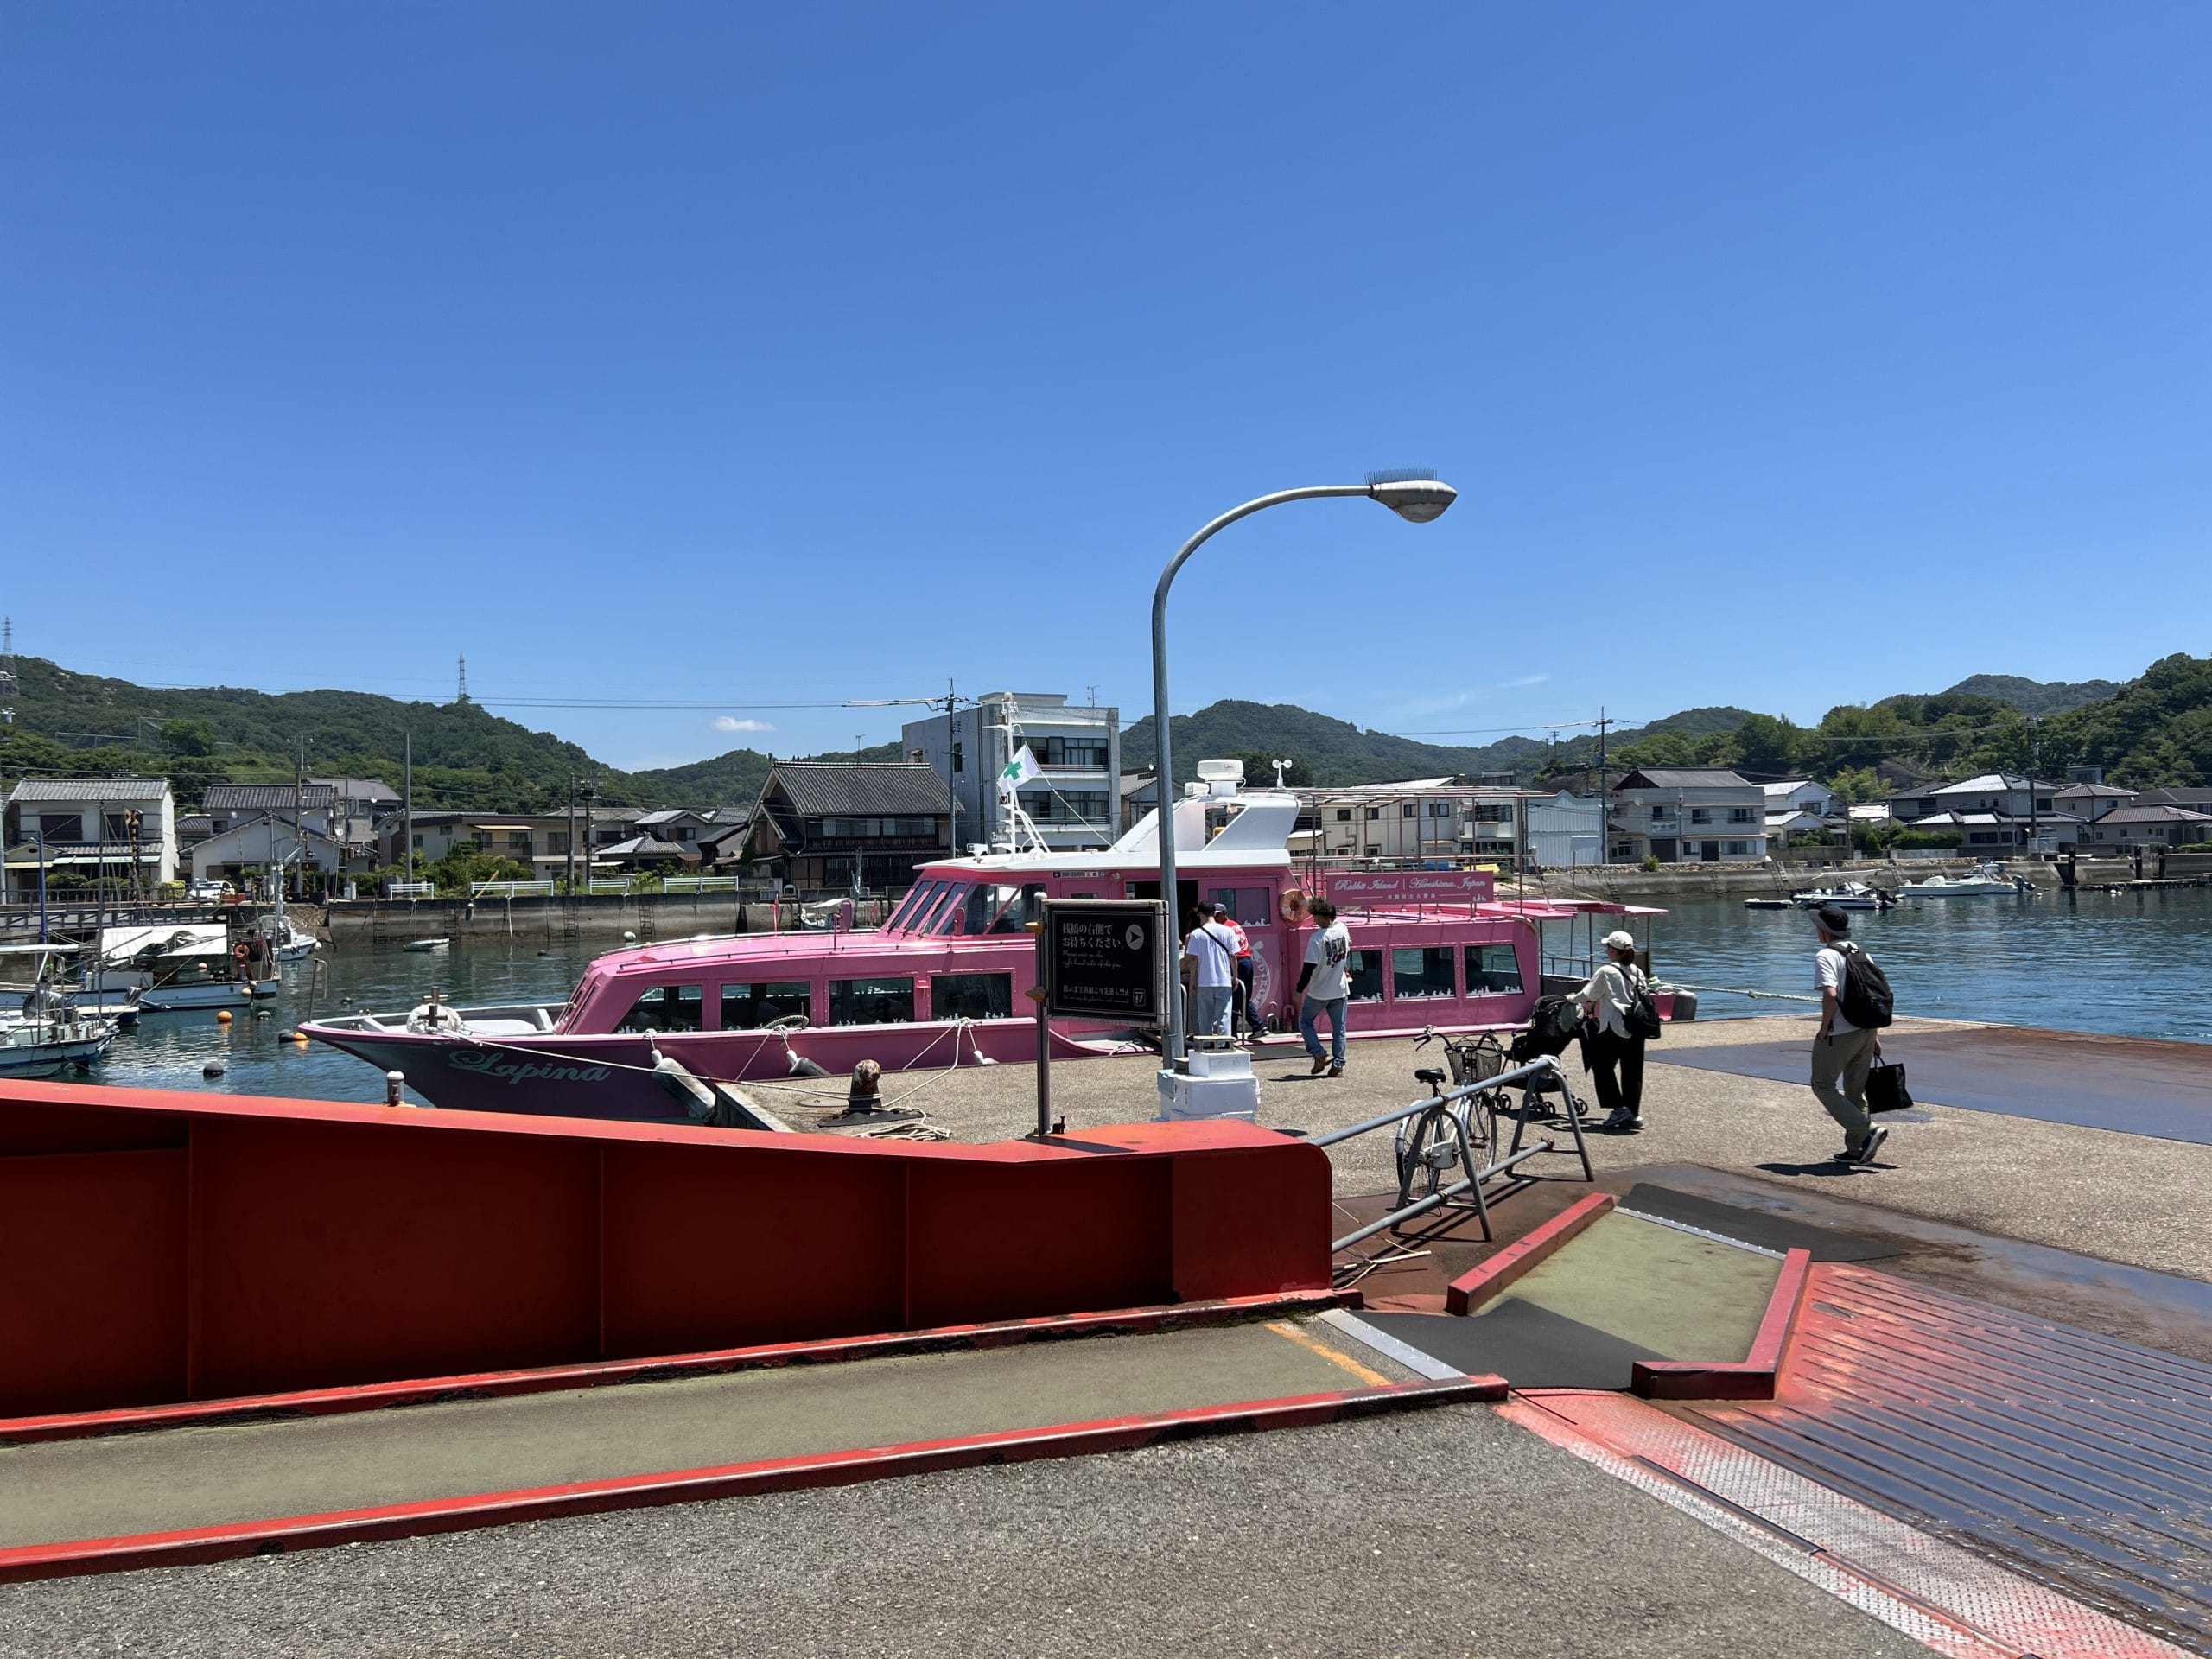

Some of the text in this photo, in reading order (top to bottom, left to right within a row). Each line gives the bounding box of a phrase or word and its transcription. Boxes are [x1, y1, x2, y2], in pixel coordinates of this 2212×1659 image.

[1334, 880, 1366, 890] Rabbit
[1367, 879, 1399, 890] Island
[1457, 876, 1486, 890] Japan
[1063, 922, 1113, 935] 桟橋の右側で
[448, 1050, 612, 1084] Lapina
